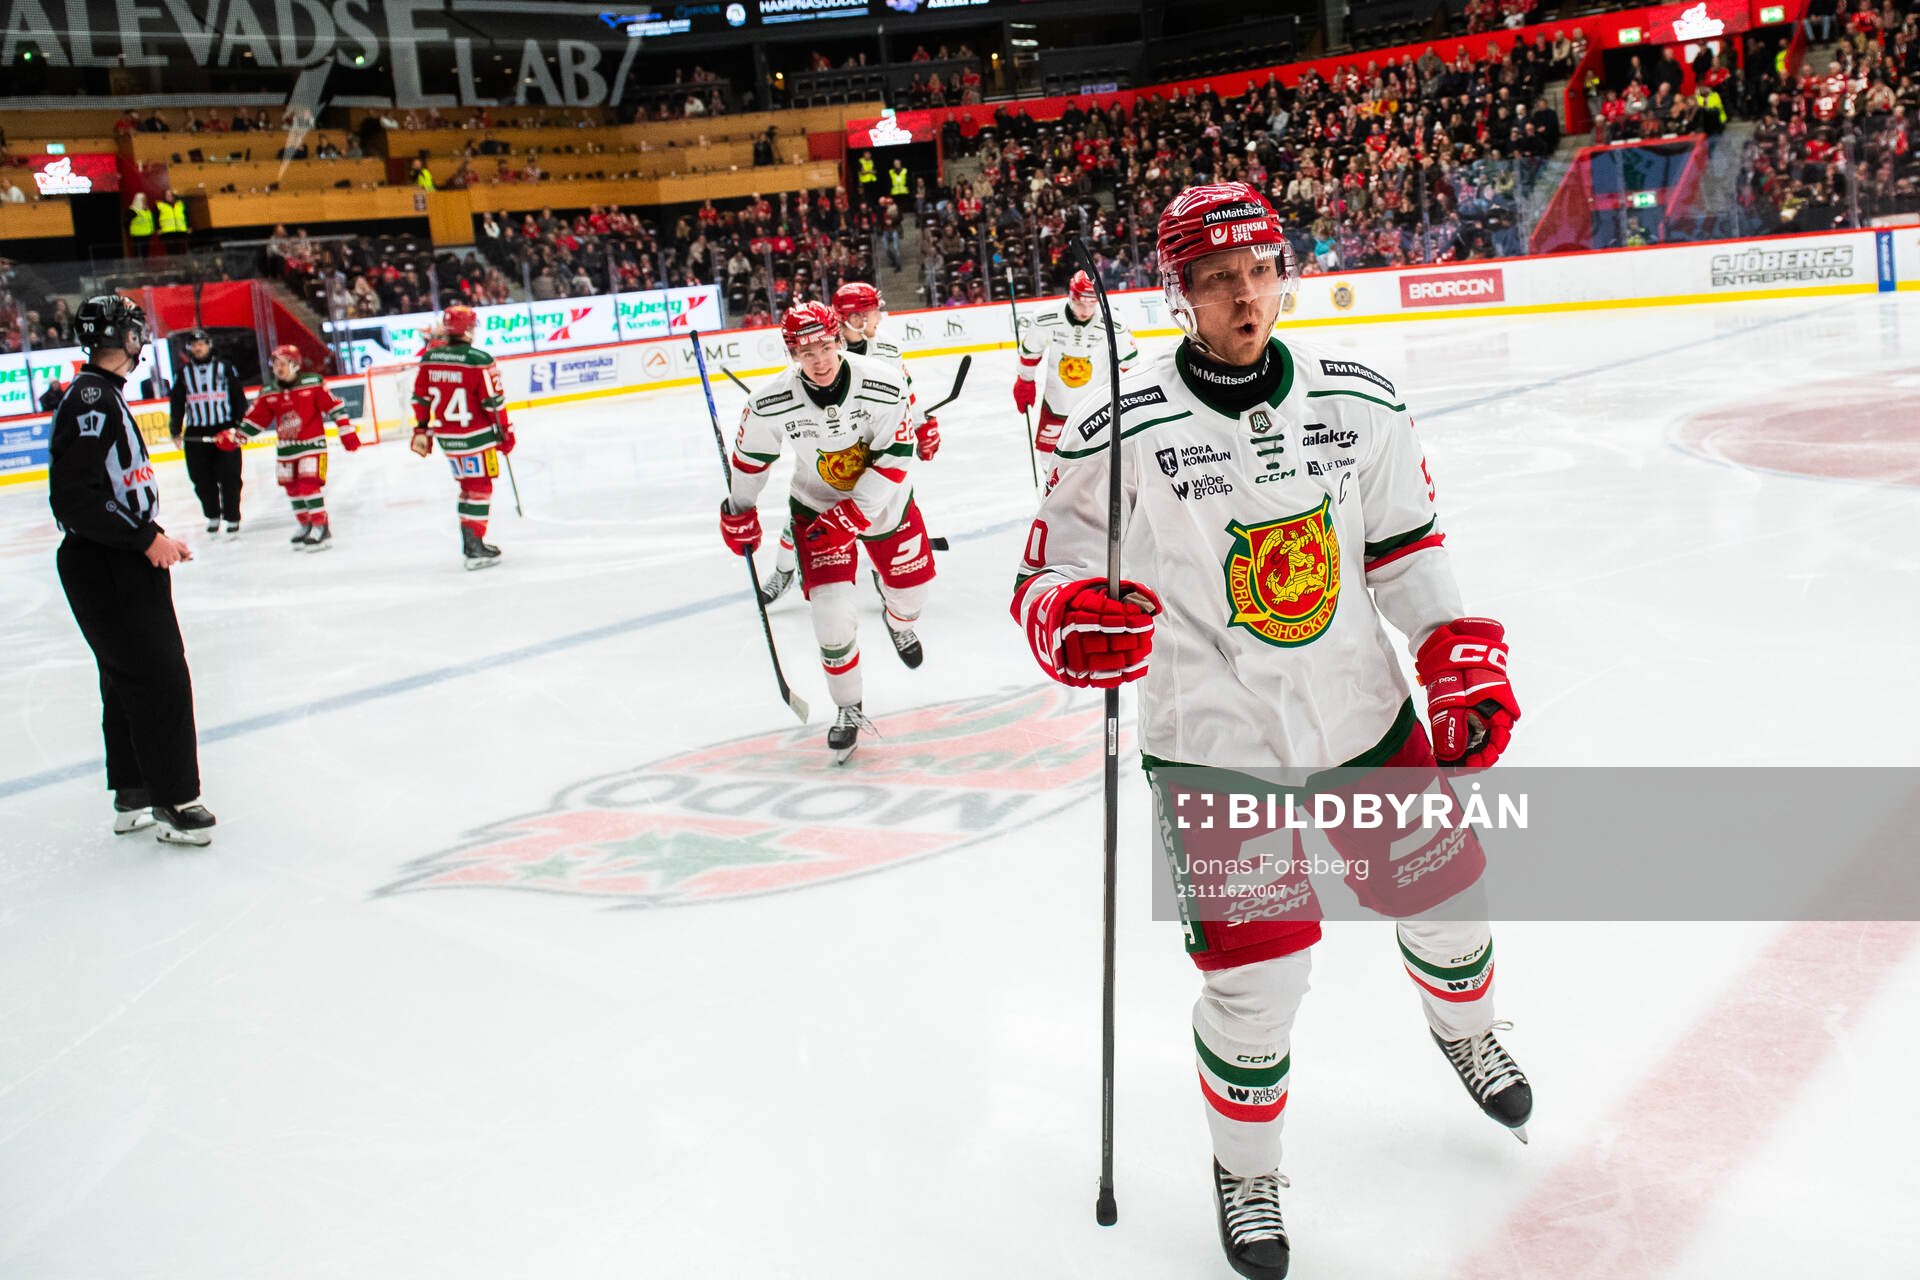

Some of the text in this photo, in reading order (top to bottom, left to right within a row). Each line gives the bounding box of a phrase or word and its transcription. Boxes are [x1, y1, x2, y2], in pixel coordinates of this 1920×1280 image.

[1222, 206, 1265, 219] Mattsson
[1231, 220, 1268, 235] SVENSKA
[1232, 230, 1254, 243] SPEL
[1712, 246, 1854, 275] SJÖBERGS
[1712, 267, 1854, 287] ENTREPRENAD
[1409, 278, 1495, 300] BRORCON
[82, 322, 95, 333] 90
[486, 311, 564, 332] Byberg
[682, 342, 741, 364] WMC
[1203, 369, 1258, 385] Mattsson
[428, 386, 473, 428] 24
[1103, 391, 1161, 421] Mttsson
[1181, 444, 1213, 457] MORA
[1183, 452, 1232, 467] KOMMUN
[1192, 474, 1225, 488] wibe
[1255, 469, 1296, 484] CCM
[1194, 482, 1233, 500] group
[1233, 564, 1253, 612] MORA
[1439, 675, 1458, 684] PRO
[584, 773, 1037, 829] MODO
[1396, 833, 1467, 888] SPORT
[1226, 891, 1312, 928] SPORT
[1450, 944, 1484, 964] CCM
[1236, 1052, 1277, 1064] CCM
